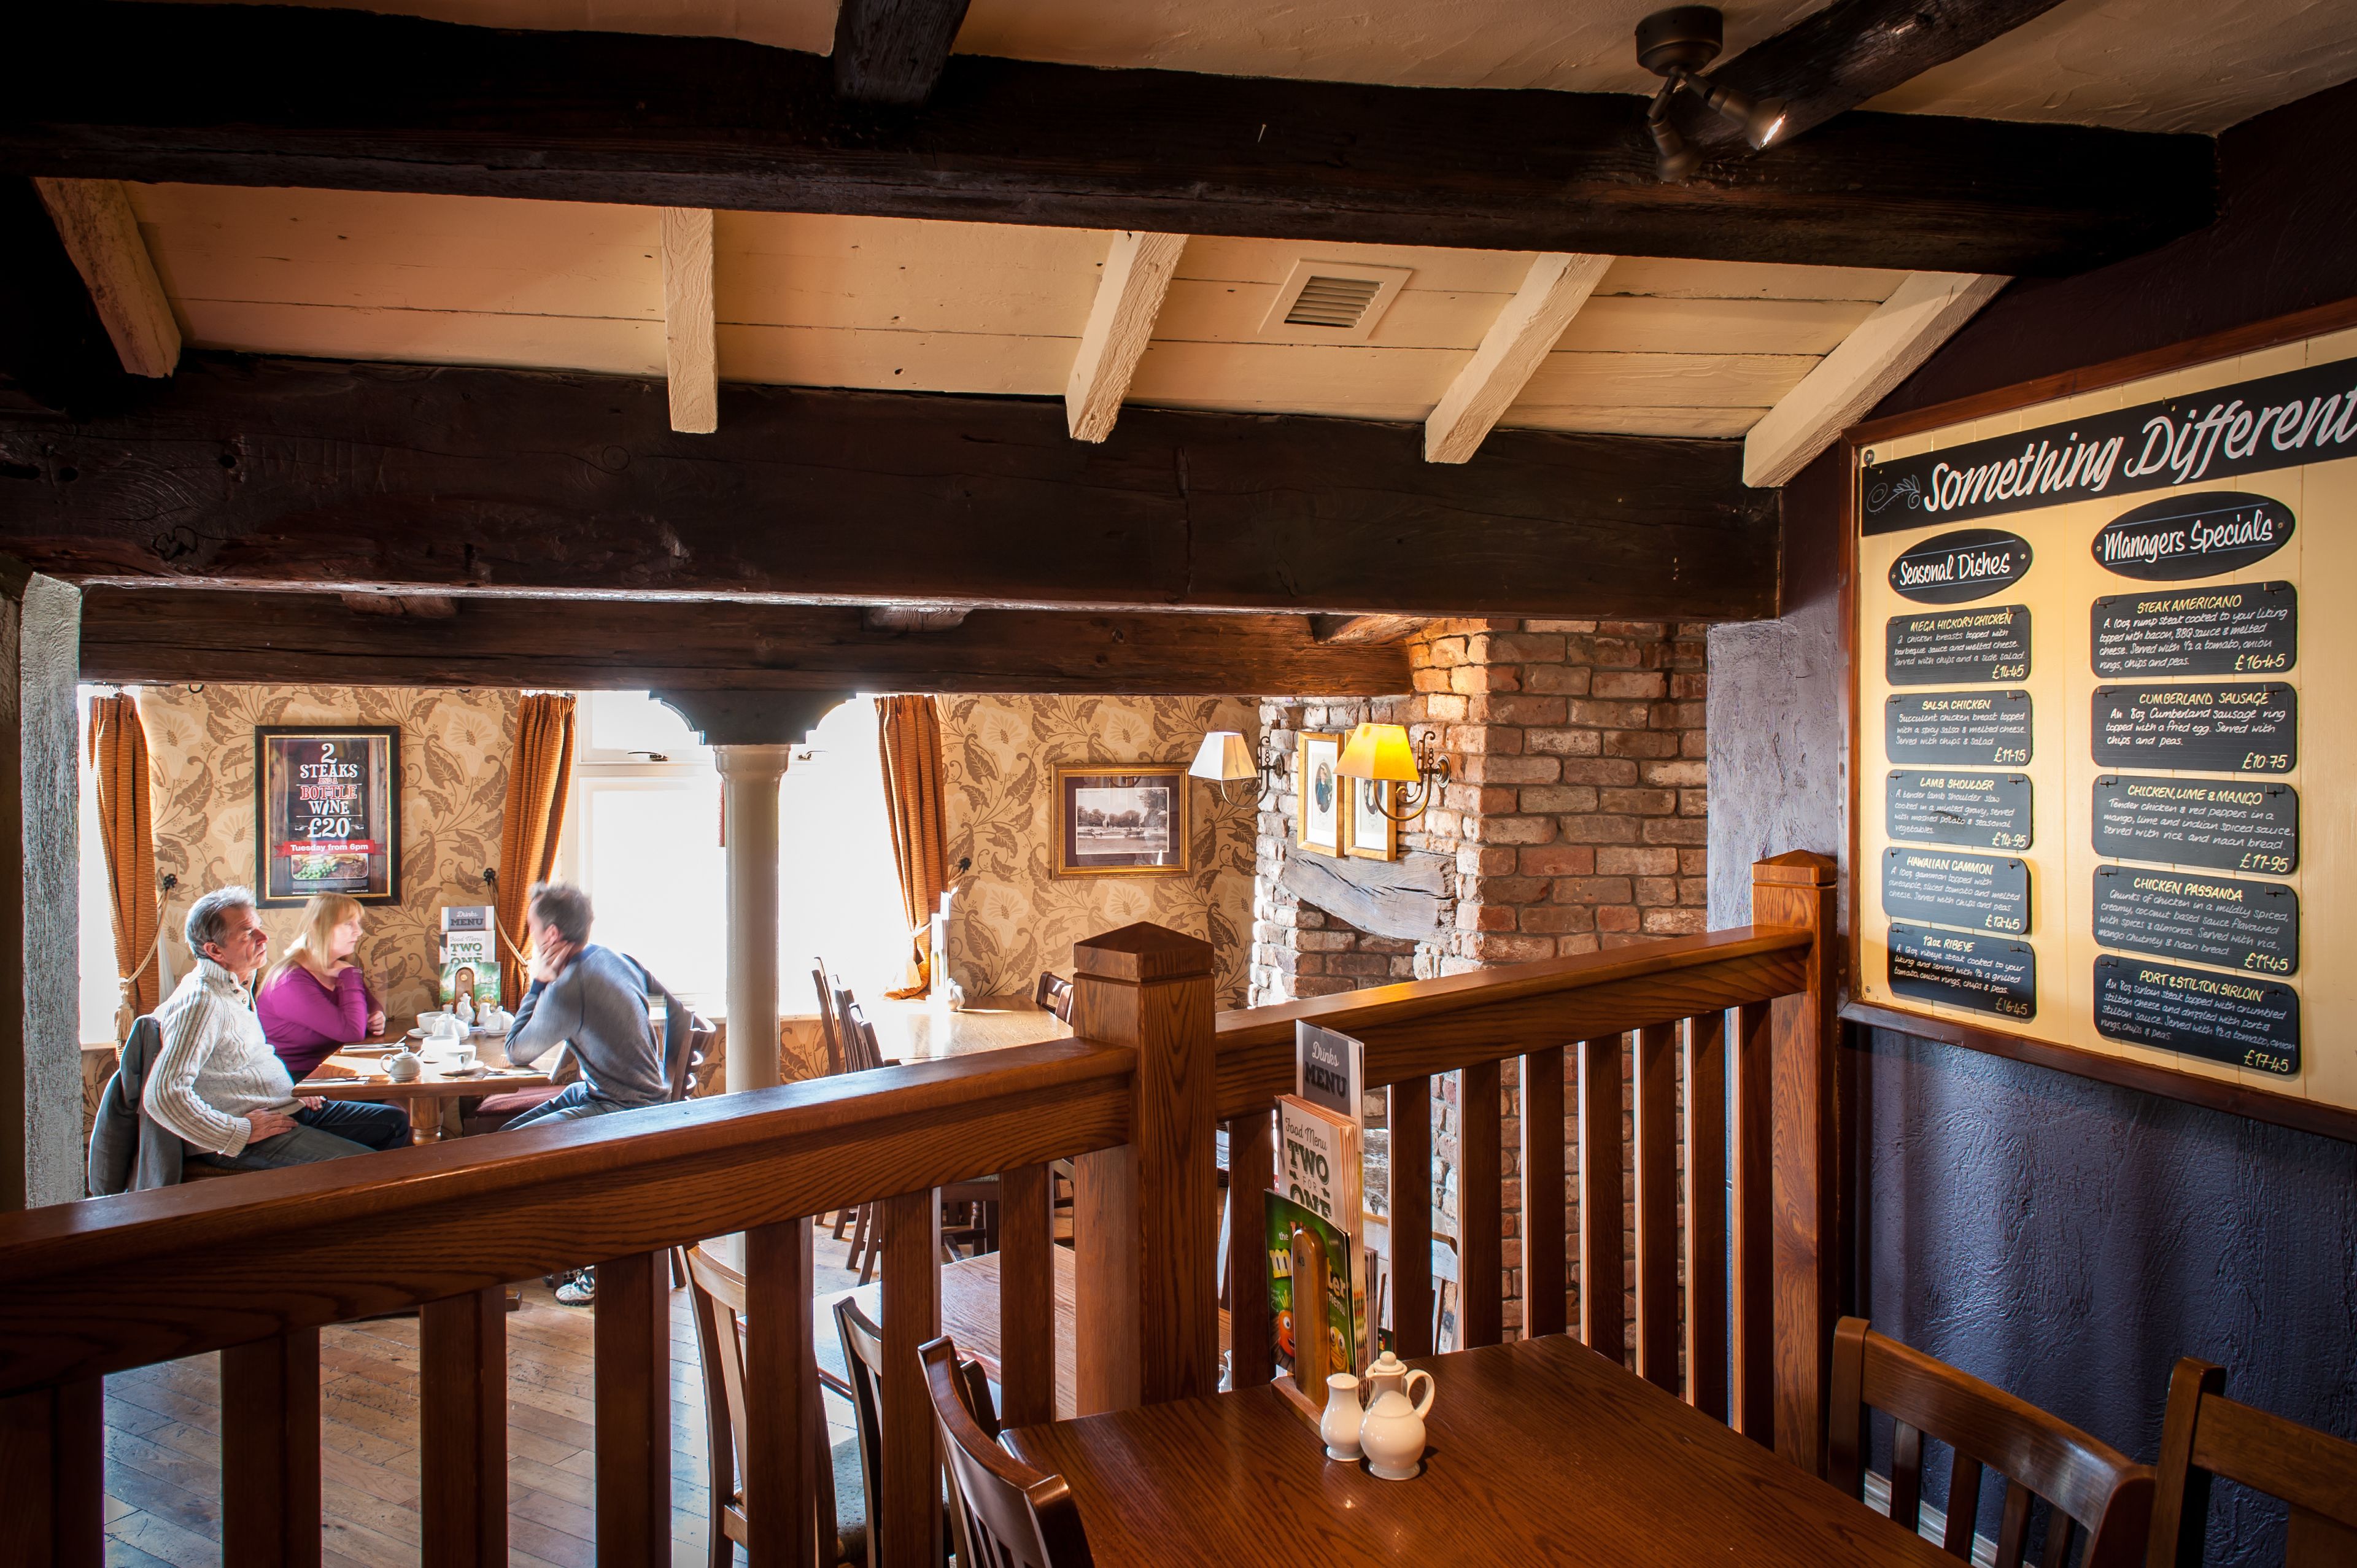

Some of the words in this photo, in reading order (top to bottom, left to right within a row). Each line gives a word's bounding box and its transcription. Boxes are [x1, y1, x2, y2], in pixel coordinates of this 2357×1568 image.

[1924, 432, 2124, 512] Something
[2104, 528, 2186, 562] Managers
[2189, 509, 2273, 553] Specials
[1900, 553, 1954, 586] Seasonal
[1957, 552, 2011, 580] Dishes
[2137, 600, 2169, 614] STEAK
[2170, 595, 2242, 611] AMERICANO
[1910, 620, 1935, 632] MEGA
[1937, 616, 1973, 629] HICKORY
[1974, 612, 2013, 626] CHICKEN
[2103, 618, 2110, 628] A
[2133, 617, 2158, 628] rump
[2159, 614, 2182, 625] steak
[2185, 613, 2216, 624] cooked
[2220, 611, 2229, 620] to
[2232, 611, 2254, 623] your
[2256, 605, 2288, 619] liking
[1907, 634, 1932, 643] chicken
[1935, 632, 1962, 641] breasts
[1965, 630, 1988, 639] topped
[1992, 628, 2008, 637] with
[2099, 633, 2123, 644] topped
[2124, 630, 2142, 641] with
[2144, 630, 2173, 639] bacon,
[2175, 628, 2193, 639] BBQ
[2193, 628, 2220, 637] sauce
[2229, 624, 2267, 634] melted
[1965, 641, 1991, 651] melted
[1922, 700, 1949, 710] SALSA
[1951, 700, 1991, 710] CHICKEN
[2139, 693, 2213, 705] CUMBERLAND
[2218, 692, 2269, 706] SAUSAGE
[1898, 714, 1938, 722] Succulent
[2000, 712, 2025, 722] topped
[2110, 708, 2122, 719] An
[2131, 708, 2145, 722] 8oz
[2150, 708, 2212, 719] Cumberland
[2213, 708, 2256, 722] sausage
[2263, 707, 2286, 722] ring
[2106, 723, 2132, 733] topped
[2135, 722, 2156, 732] with
[2166, 720, 2190, 732] fried
[2192, 725, 2212, 735] egg.
[2216, 722, 2248, 733] Served
[2251, 722, 2276, 733] with
[2107, 735, 2131, 746] chips
[2135, 736, 2154, 745] and
[321, 743, 337, 763] 2
[300, 764, 358, 779] STEAKS
[300, 785, 357, 800] BOTTLE
[1920, 778, 1945, 788] LAMB
[1947, 779, 1994, 790] SHOULDER
[2178, 788, 2205, 800] LIME
[2208, 792, 2215, 801] &
[2216, 790, 2262, 806] MANGO
[308, 799, 350, 816] WINE
[2108, 798, 2138, 809] Tender
[2141, 802, 2177, 813] chicken
[2188, 806, 2206, 815] red
[2207, 808, 2247, 818] peppers
[2251, 809, 2263, 819] in
[2103, 813, 2134, 824] mango,
[2136, 814, 2158, 825] lime
[2160, 817, 2180, 827] and
[2182, 817, 2218, 830] indian
[2220, 821, 2253, 833] spiced
[2254, 825, 2295, 837] sauce,
[2103, 825, 2131, 836] served
[2135, 827, 2159, 838] with
[2163, 830, 2183, 841] rice
[2188, 833, 2208, 843] and
[2213, 836, 2244, 846] naan
[1907, 856, 1950, 870] HAWAIIAN
[1951, 860, 1994, 875] GAMMON
[2134, 877, 2181, 895] CHICKEN
[2184, 882, 2243, 902] PASSANDA
[2110, 889, 2140, 902] Chunks
[2142, 892, 2153, 902] of
[2153, 895, 2189, 907] chicken
[2193, 900, 2203, 910] in
[2216, 904, 2252, 918] mildly
[2253, 909, 2288, 922] spiced,
[2101, 902, 2134, 916] creamy,
[2135, 907, 2171, 919] coconut
[2173, 911, 2200, 923] based
[2202, 917, 2229, 928] sauce
[2231, 918, 2280, 935] flavoured
[1923, 935, 1941, 947] 12oz
[1943, 938, 1975, 952] RIBEYE
[1896, 944, 1901, 952] A
[1920, 949, 1942, 960] ribeye
[1945, 954, 1965, 962] steak
[1967, 958, 1993, 967] cooked
[2139, 970, 2169, 983] PORT
[2169, 977, 2177, 986] &
[2177, 977, 2220, 995] STILTON
[2220, 982, 2264, 1002] SIRLOIN
[1312, 1041, 1339, 1067] Drinks
[1305, 1061, 1347, 1099] MENU
[1285, 1118, 1303, 1138] Food
[1305, 1127, 1327, 1151] Menu
[1287, 1138, 1329, 1185] TWO
[1303, 1176, 1317, 1192] FOR
[1279, 1232, 1288, 1240] the
[1328, 1292, 1345, 1316] menu
